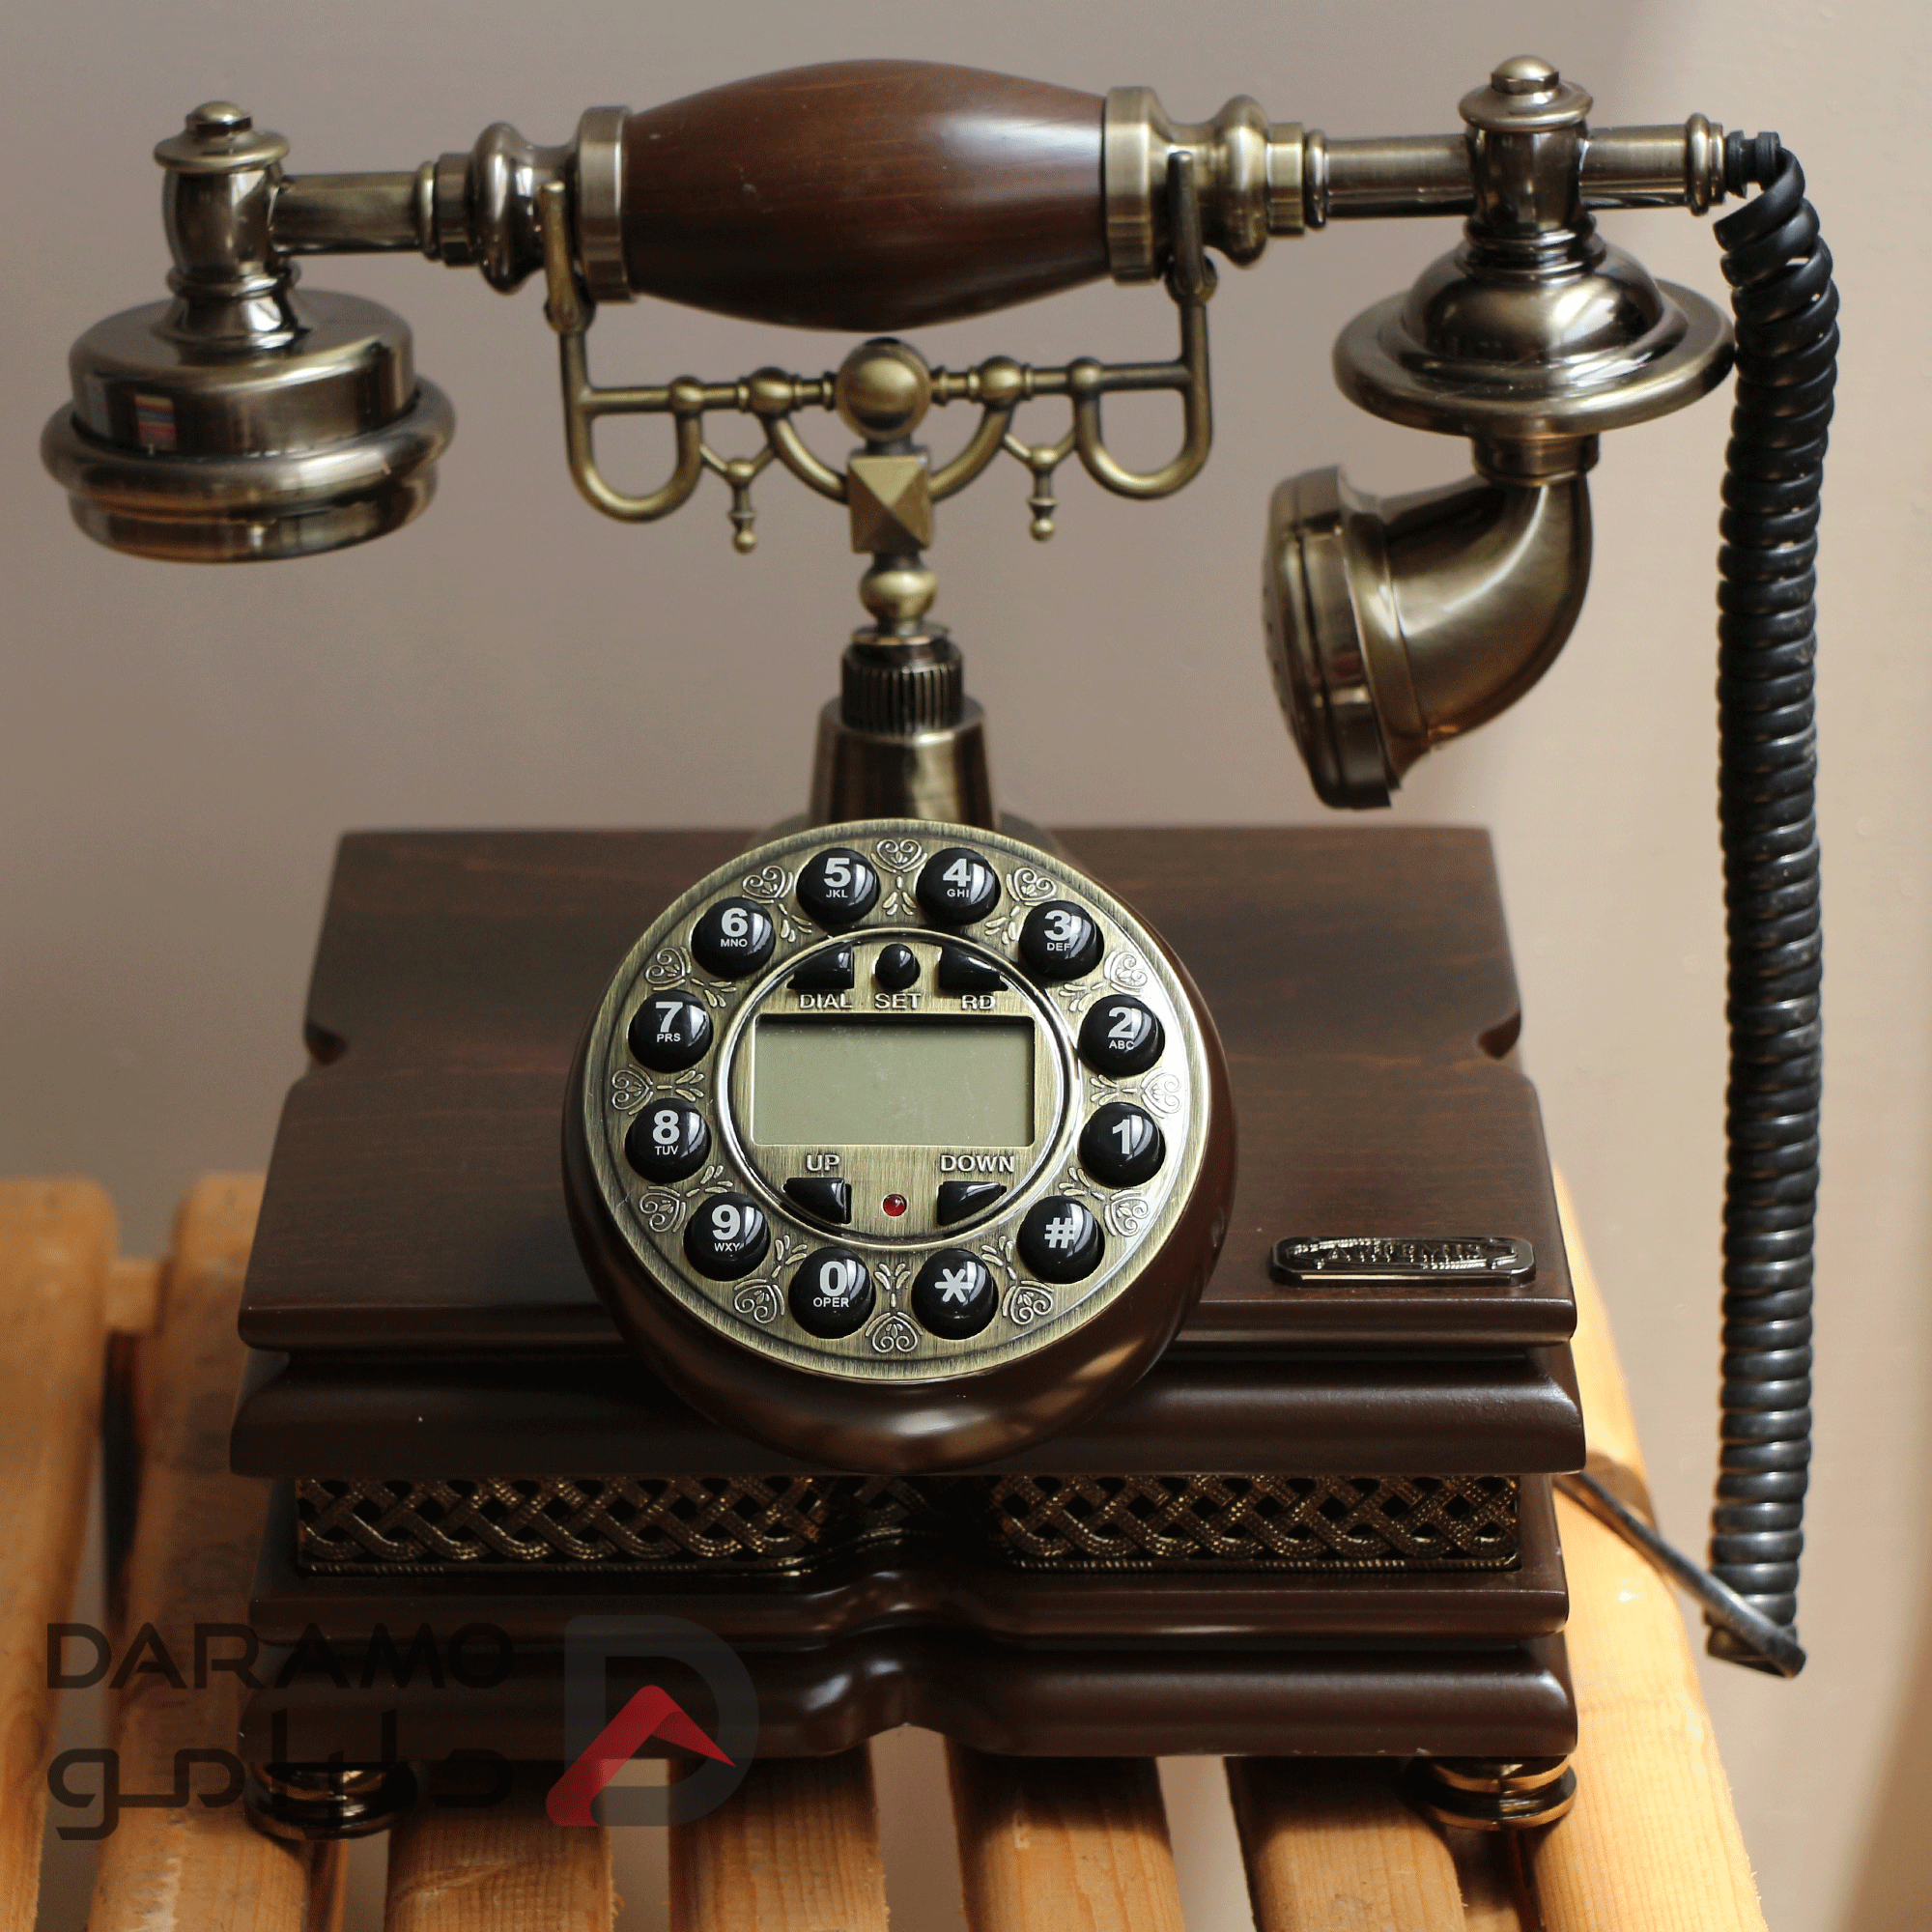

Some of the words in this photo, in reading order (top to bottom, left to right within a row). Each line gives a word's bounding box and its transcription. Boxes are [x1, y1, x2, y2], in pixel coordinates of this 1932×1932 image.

[823, 858, 851, 888] 5
[943, 858, 971, 887] 4
[825, 889, 848, 898] JKL
[947, 888, 970, 898] GHI
[721, 907, 749, 937] 6
[1044, 910, 1072, 941] 3
[720, 938, 748, 948] MNO
[1046, 942, 1071, 952] DEF
[799, 993, 853, 1009] DIAL
[874, 993, 921, 1009] SET
[961, 994, 996, 1010] RD
[655, 1001, 683, 1033] 7
[1108, 1007, 1136, 1038] 2
[656, 1033, 681, 1043] PRS
[1109, 1039, 1135, 1050] ABC
[652, 1110, 680, 1145] 8
[1112, 1119, 1131, 1154] 1
[655, 1146, 678, 1155] TUV
[807, 1153, 840, 1172] UP
[940, 1154, 1014, 1173] DOWN
[711, 1204, 741, 1241] 9
[1044, 1217, 1075, 1249] #
[714, 1242, 741, 1252] WXY
[819, 1261, 847, 1296] 0
[812, 1296, 850, 1308] OPER
